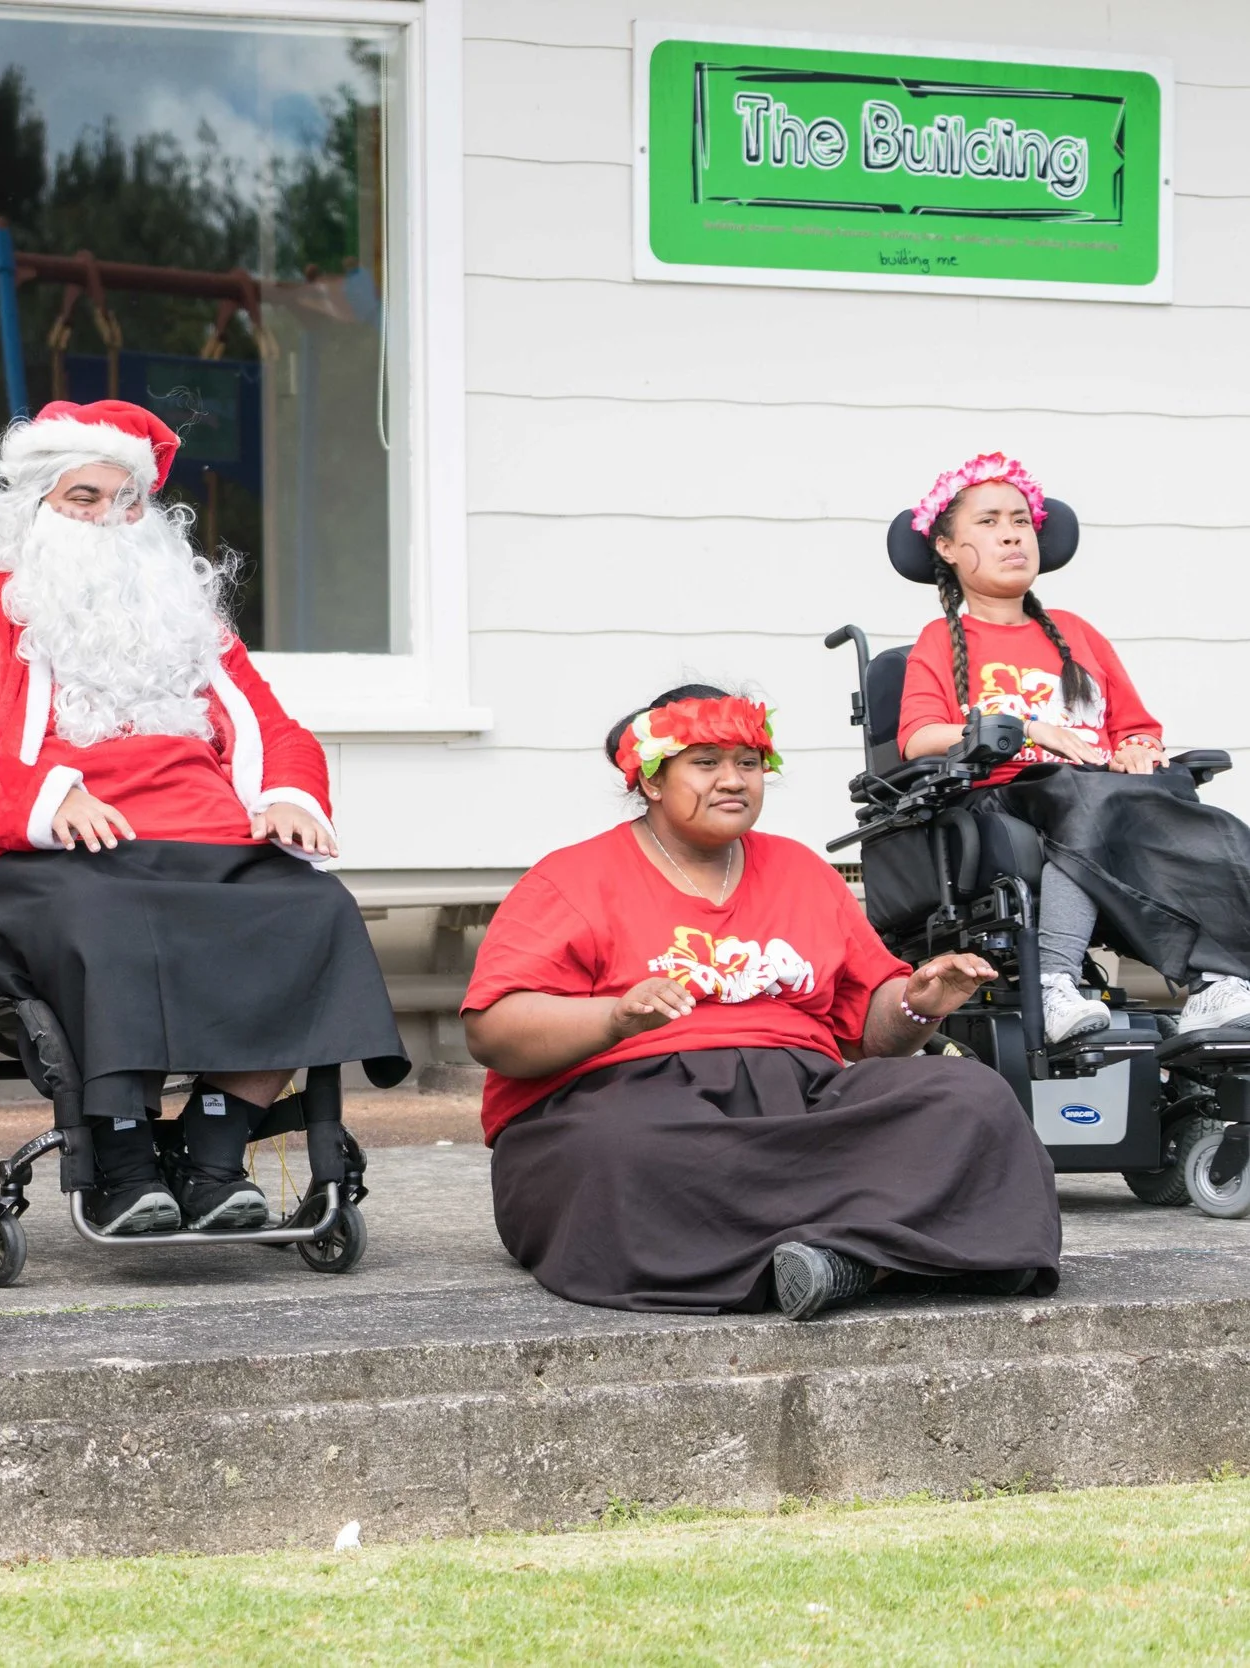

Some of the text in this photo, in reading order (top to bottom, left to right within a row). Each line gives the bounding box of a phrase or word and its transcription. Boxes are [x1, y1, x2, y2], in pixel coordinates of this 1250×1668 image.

[735, 91, 1088, 200] The Building
[879, 248, 959, 273] building me
